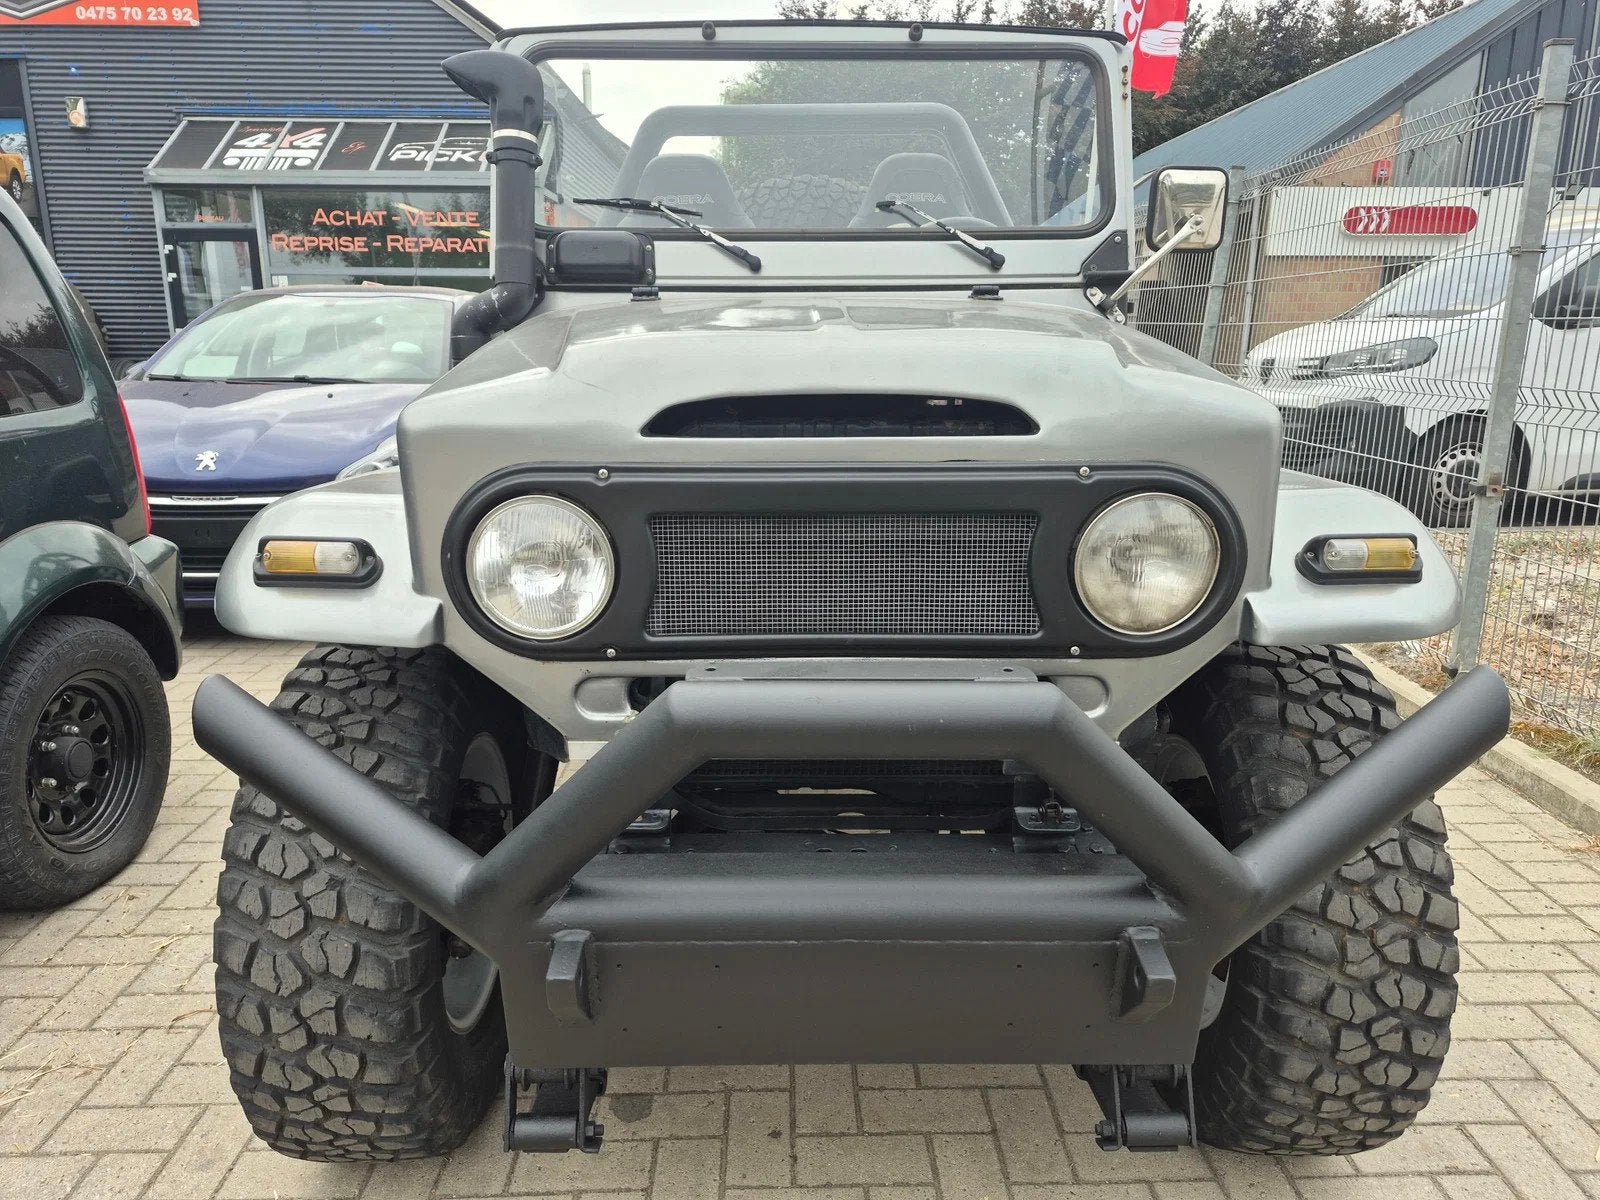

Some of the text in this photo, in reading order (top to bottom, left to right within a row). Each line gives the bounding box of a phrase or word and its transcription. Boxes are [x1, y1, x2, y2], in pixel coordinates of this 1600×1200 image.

[75, 5, 193, 21] 0475 70 23 92
[312, 208, 387, 226] ACHAT
[403, 209, 480, 227] VENTE
[271, 233, 369, 252] REPRISE
